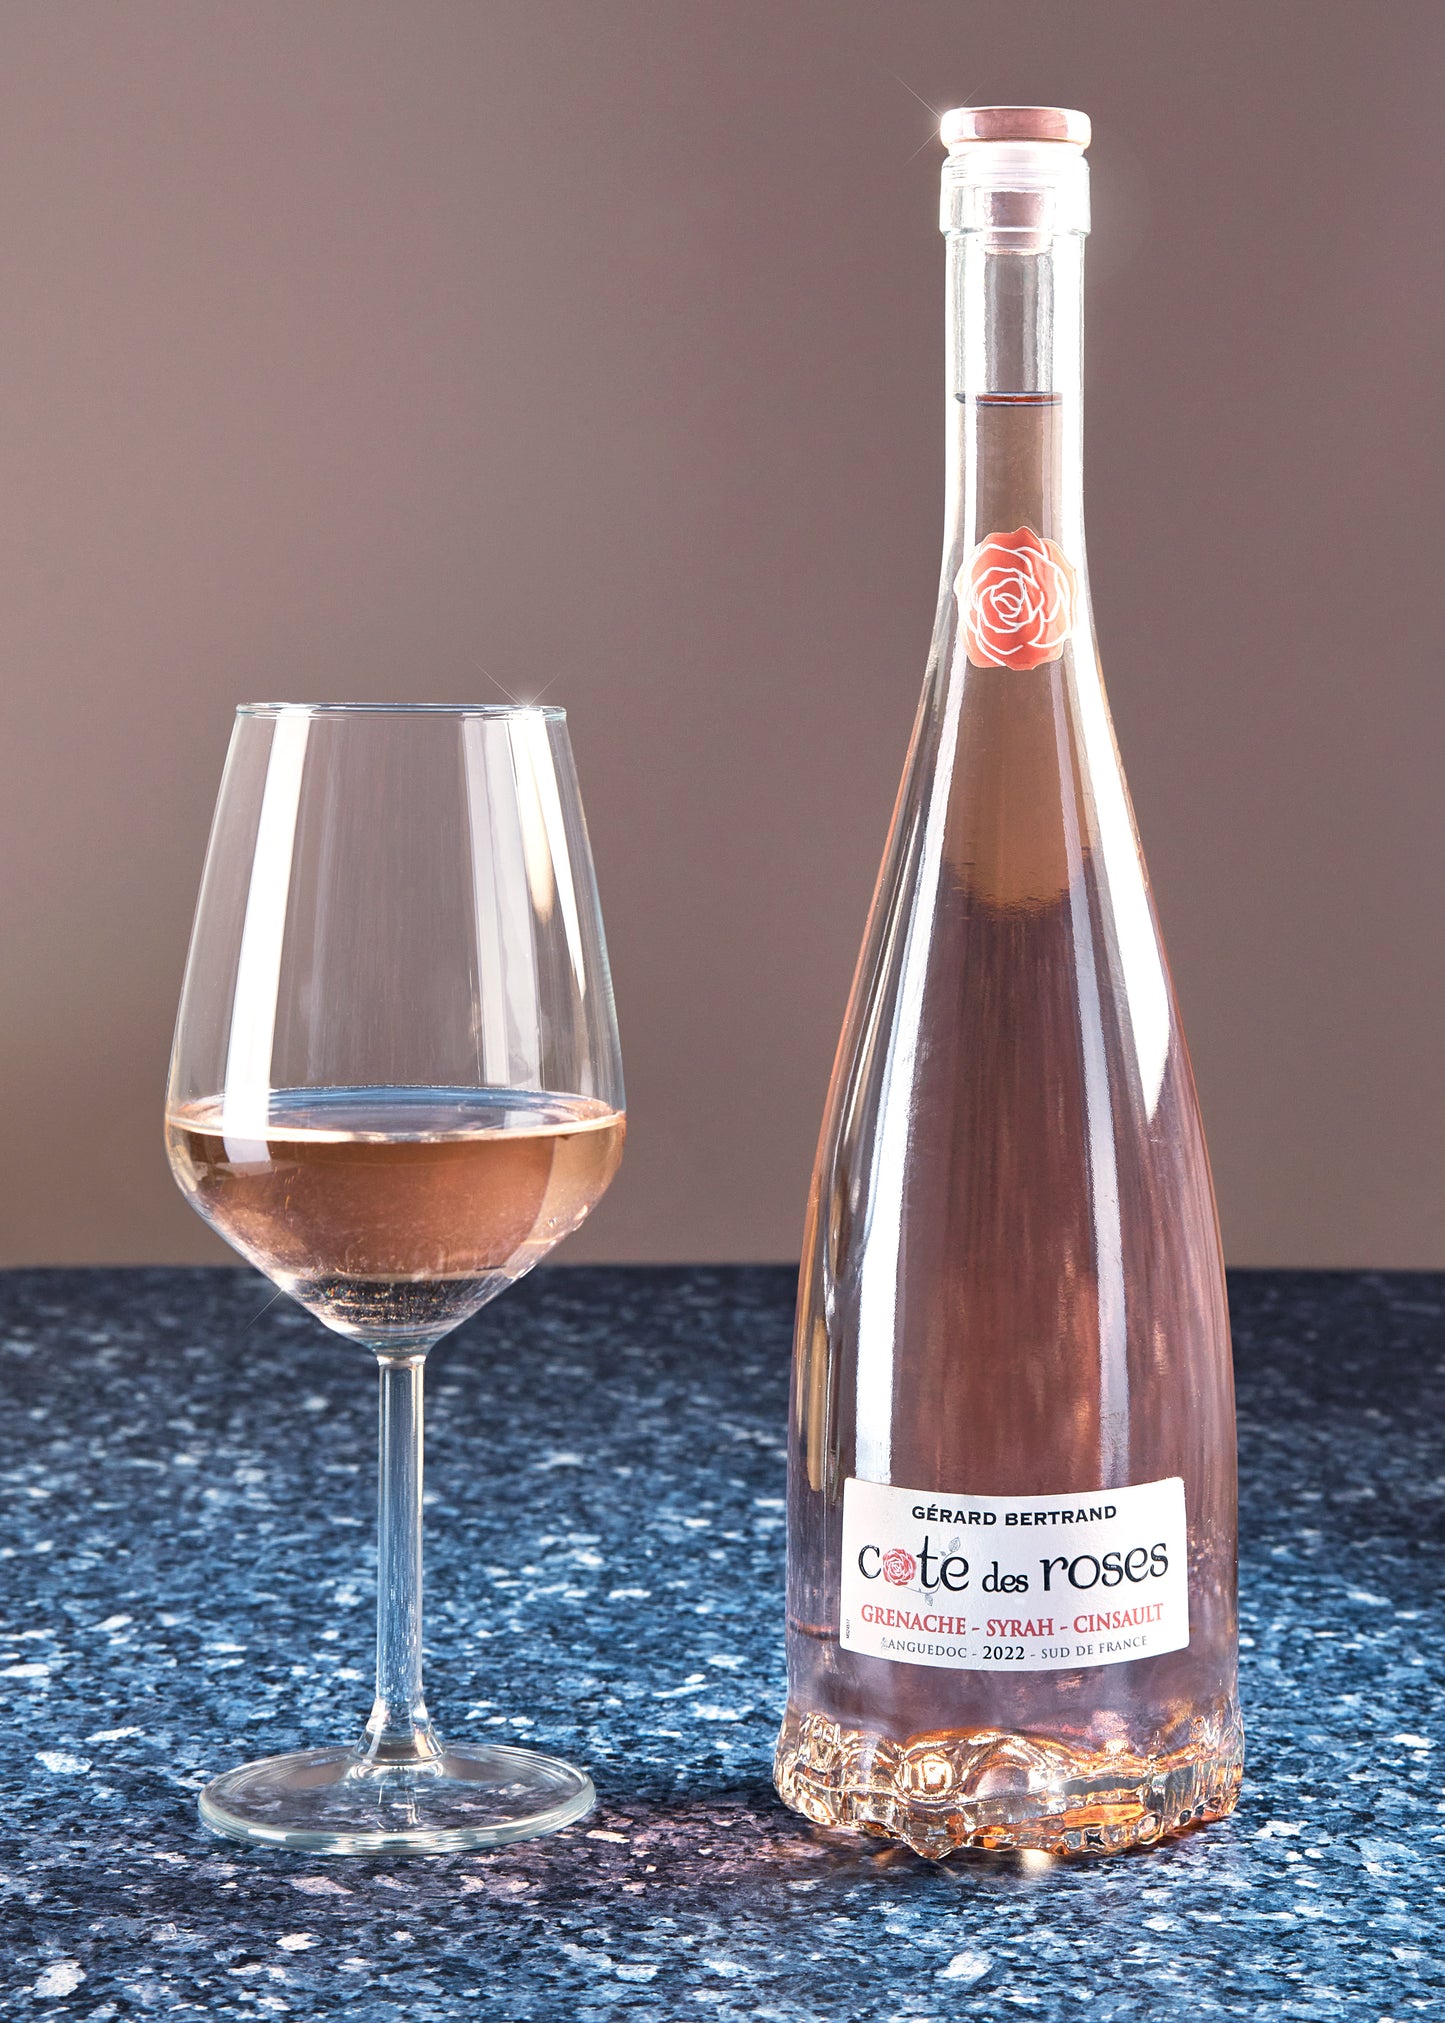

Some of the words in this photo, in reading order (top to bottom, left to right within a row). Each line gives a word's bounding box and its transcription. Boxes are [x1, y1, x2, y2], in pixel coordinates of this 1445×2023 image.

[912, 1504, 997, 1525] GÉRARD
[1005, 1506, 1116, 1526] BERTRAND
[982, 1561, 1029, 1593] des
[1039, 1543, 1168, 1591] roses
[861, 1604, 967, 1636] GRENACHE
[986, 1618, 1054, 1637] SYRAH
[1073, 1603, 1163, 1633] CINSAULT
[983, 1646, 1025, 1660] 2022
[1042, 1648, 1070, 1659] SUD
[1076, 1645, 1093, 1656] DE
[1098, 1635, 1148, 1654] FRANCE
